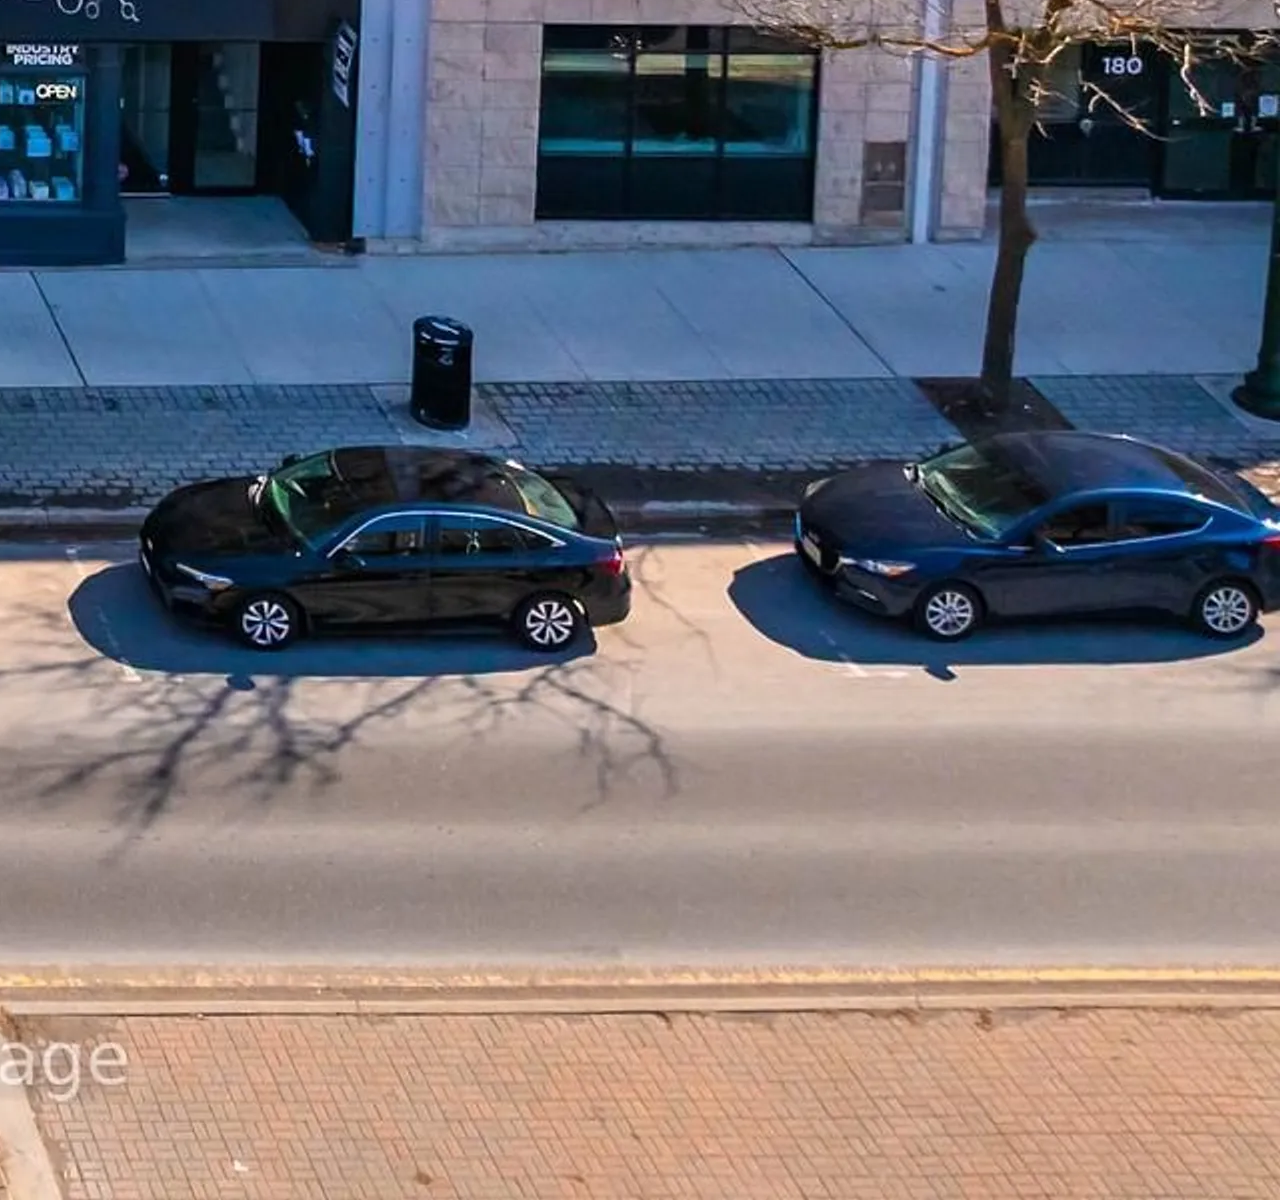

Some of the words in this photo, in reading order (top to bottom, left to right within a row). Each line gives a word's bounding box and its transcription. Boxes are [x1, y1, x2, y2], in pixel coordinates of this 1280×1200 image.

[13, 54, 73, 66] PRICING
[1102, 57, 1143, 75] 180
[36, 83, 77, 100] OPEN
